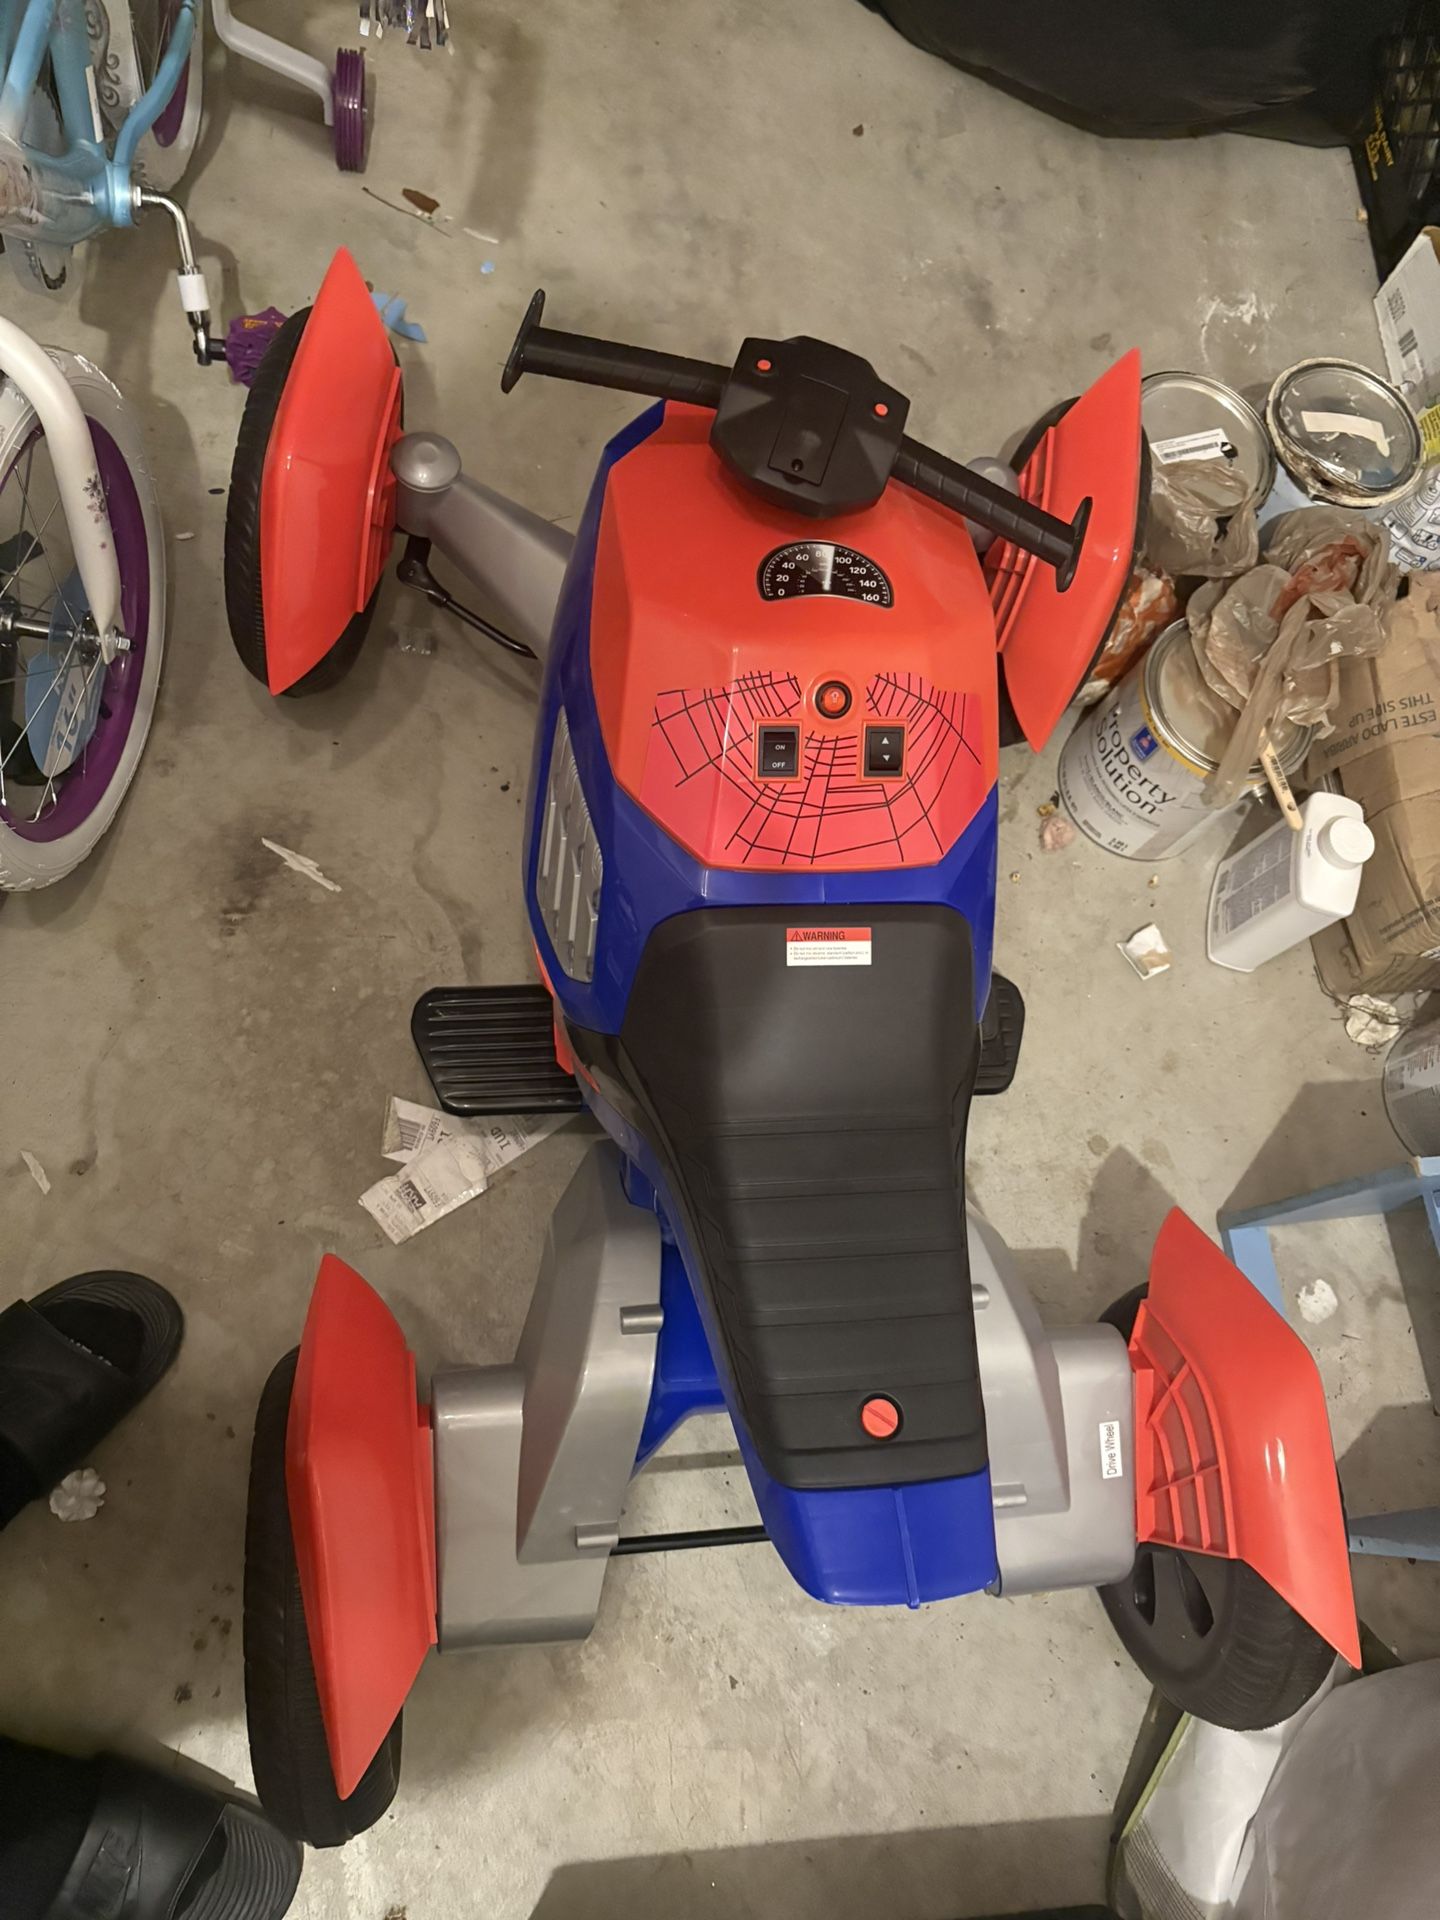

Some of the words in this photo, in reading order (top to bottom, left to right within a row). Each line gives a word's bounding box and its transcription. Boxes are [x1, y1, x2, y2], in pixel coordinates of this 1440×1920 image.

[795, 553, 809, 562] 60
[815, 550, 828, 558] 80
[835, 556, 852, 564] 100
[782, 561, 796, 570] 40
[849, 566, 867, 575] 120
[776, 574, 789, 583] 20
[859, 579, 877, 588] 140
[777, 588, 785, 597] 0
[862, 593, 880, 602] 160
[1398, 692, 1434, 710] THIS
[1348, 712, 1365, 728] UP
[1402, 709, 1437, 728] ESTE
[1361, 718, 1398, 741] LADO
[774, 743, 786, 751] ON
[771, 761, 786, 769] OFF
[802, 930, 846, 941] WARNING
[1104, 1423, 1115, 1452] Wheel
[1106, 1452, 1118, 1476] Drive
